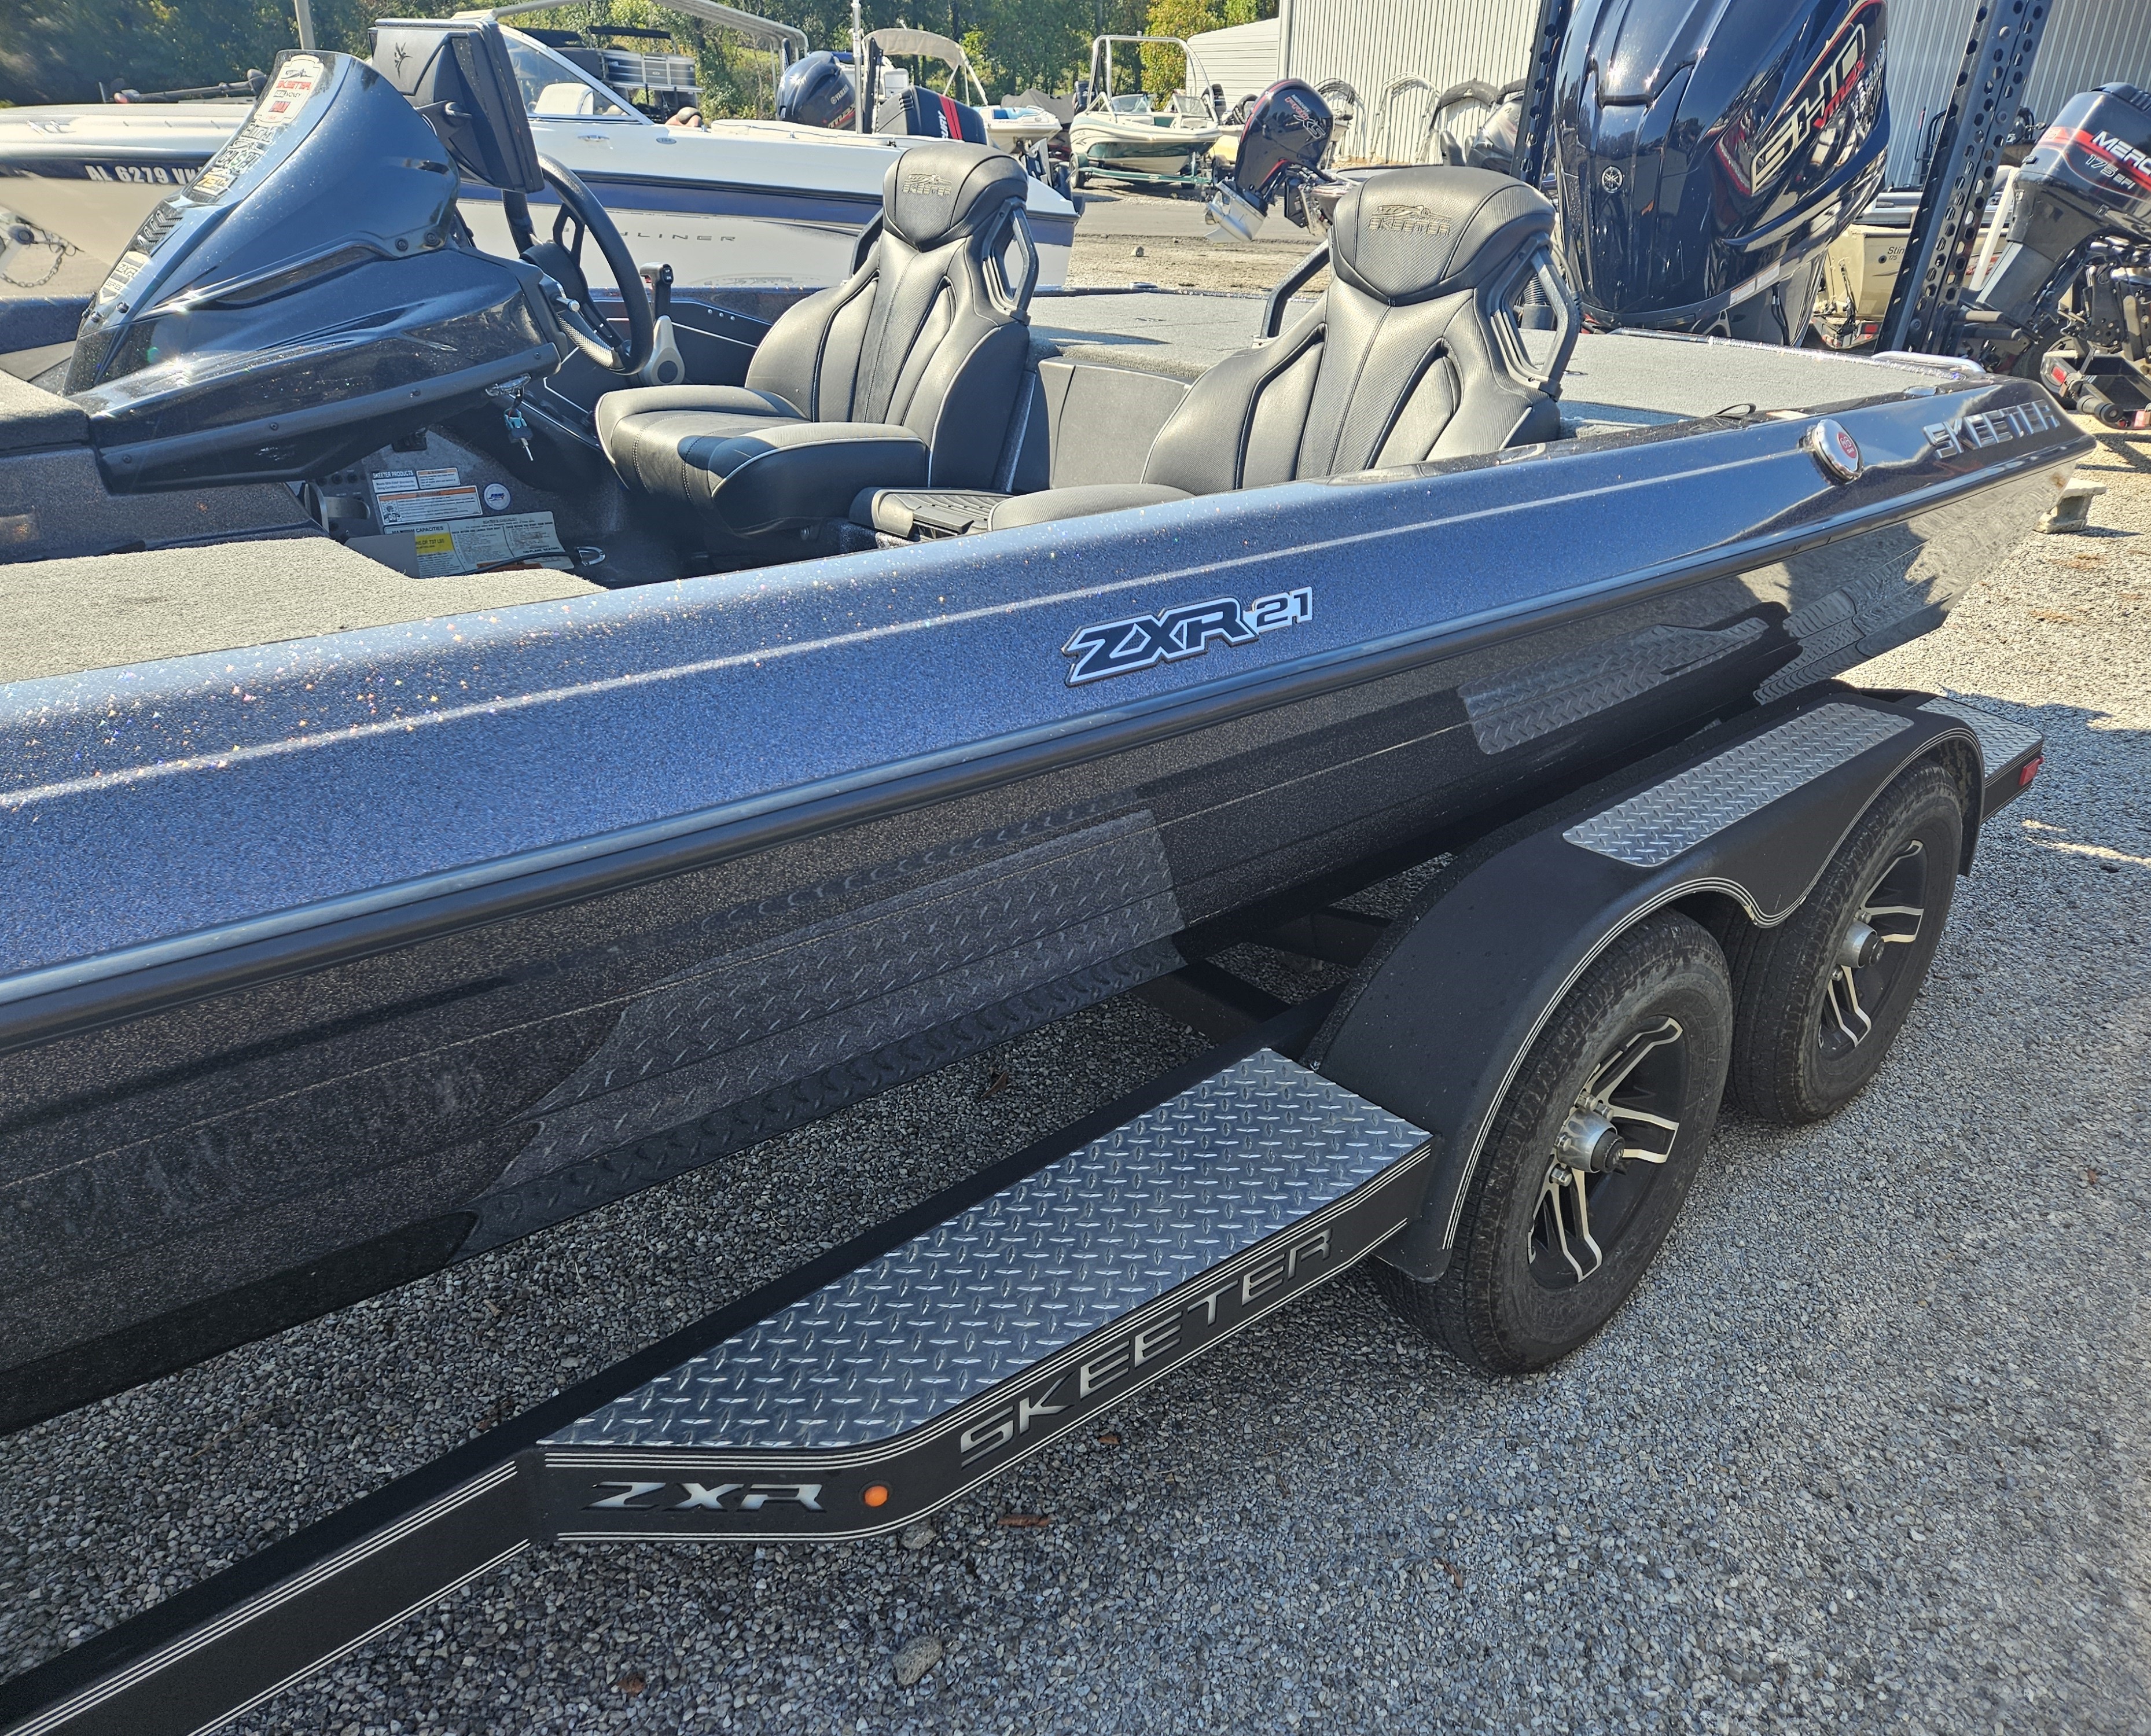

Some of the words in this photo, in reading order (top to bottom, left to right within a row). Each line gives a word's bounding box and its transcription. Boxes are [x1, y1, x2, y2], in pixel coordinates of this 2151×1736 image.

[1291, 94, 1311, 113] MERCURY
[937, 111, 948, 138] CURY
[1293, 114, 1326, 139] XS
[2093, 131, 2151, 176] MERC
[85, 165, 113, 181] AL
[115, 166, 169, 184] 6279
[2086, 154, 2118, 178] 175
[2113, 174, 2136, 190] EFI
[902, 184, 951, 197] SKEETER
[1369, 218, 1451, 236] SKEETER
[1888, 247, 1905, 255] Stin
[1923, 399, 2061, 458] SKEETER
[1067, 597, 1255, 683] ZXR
[1253, 587, 1312, 633] 21
[959, 1228, 1331, 1469] SKEETER
[586, 1481, 826, 1511] ZXR
